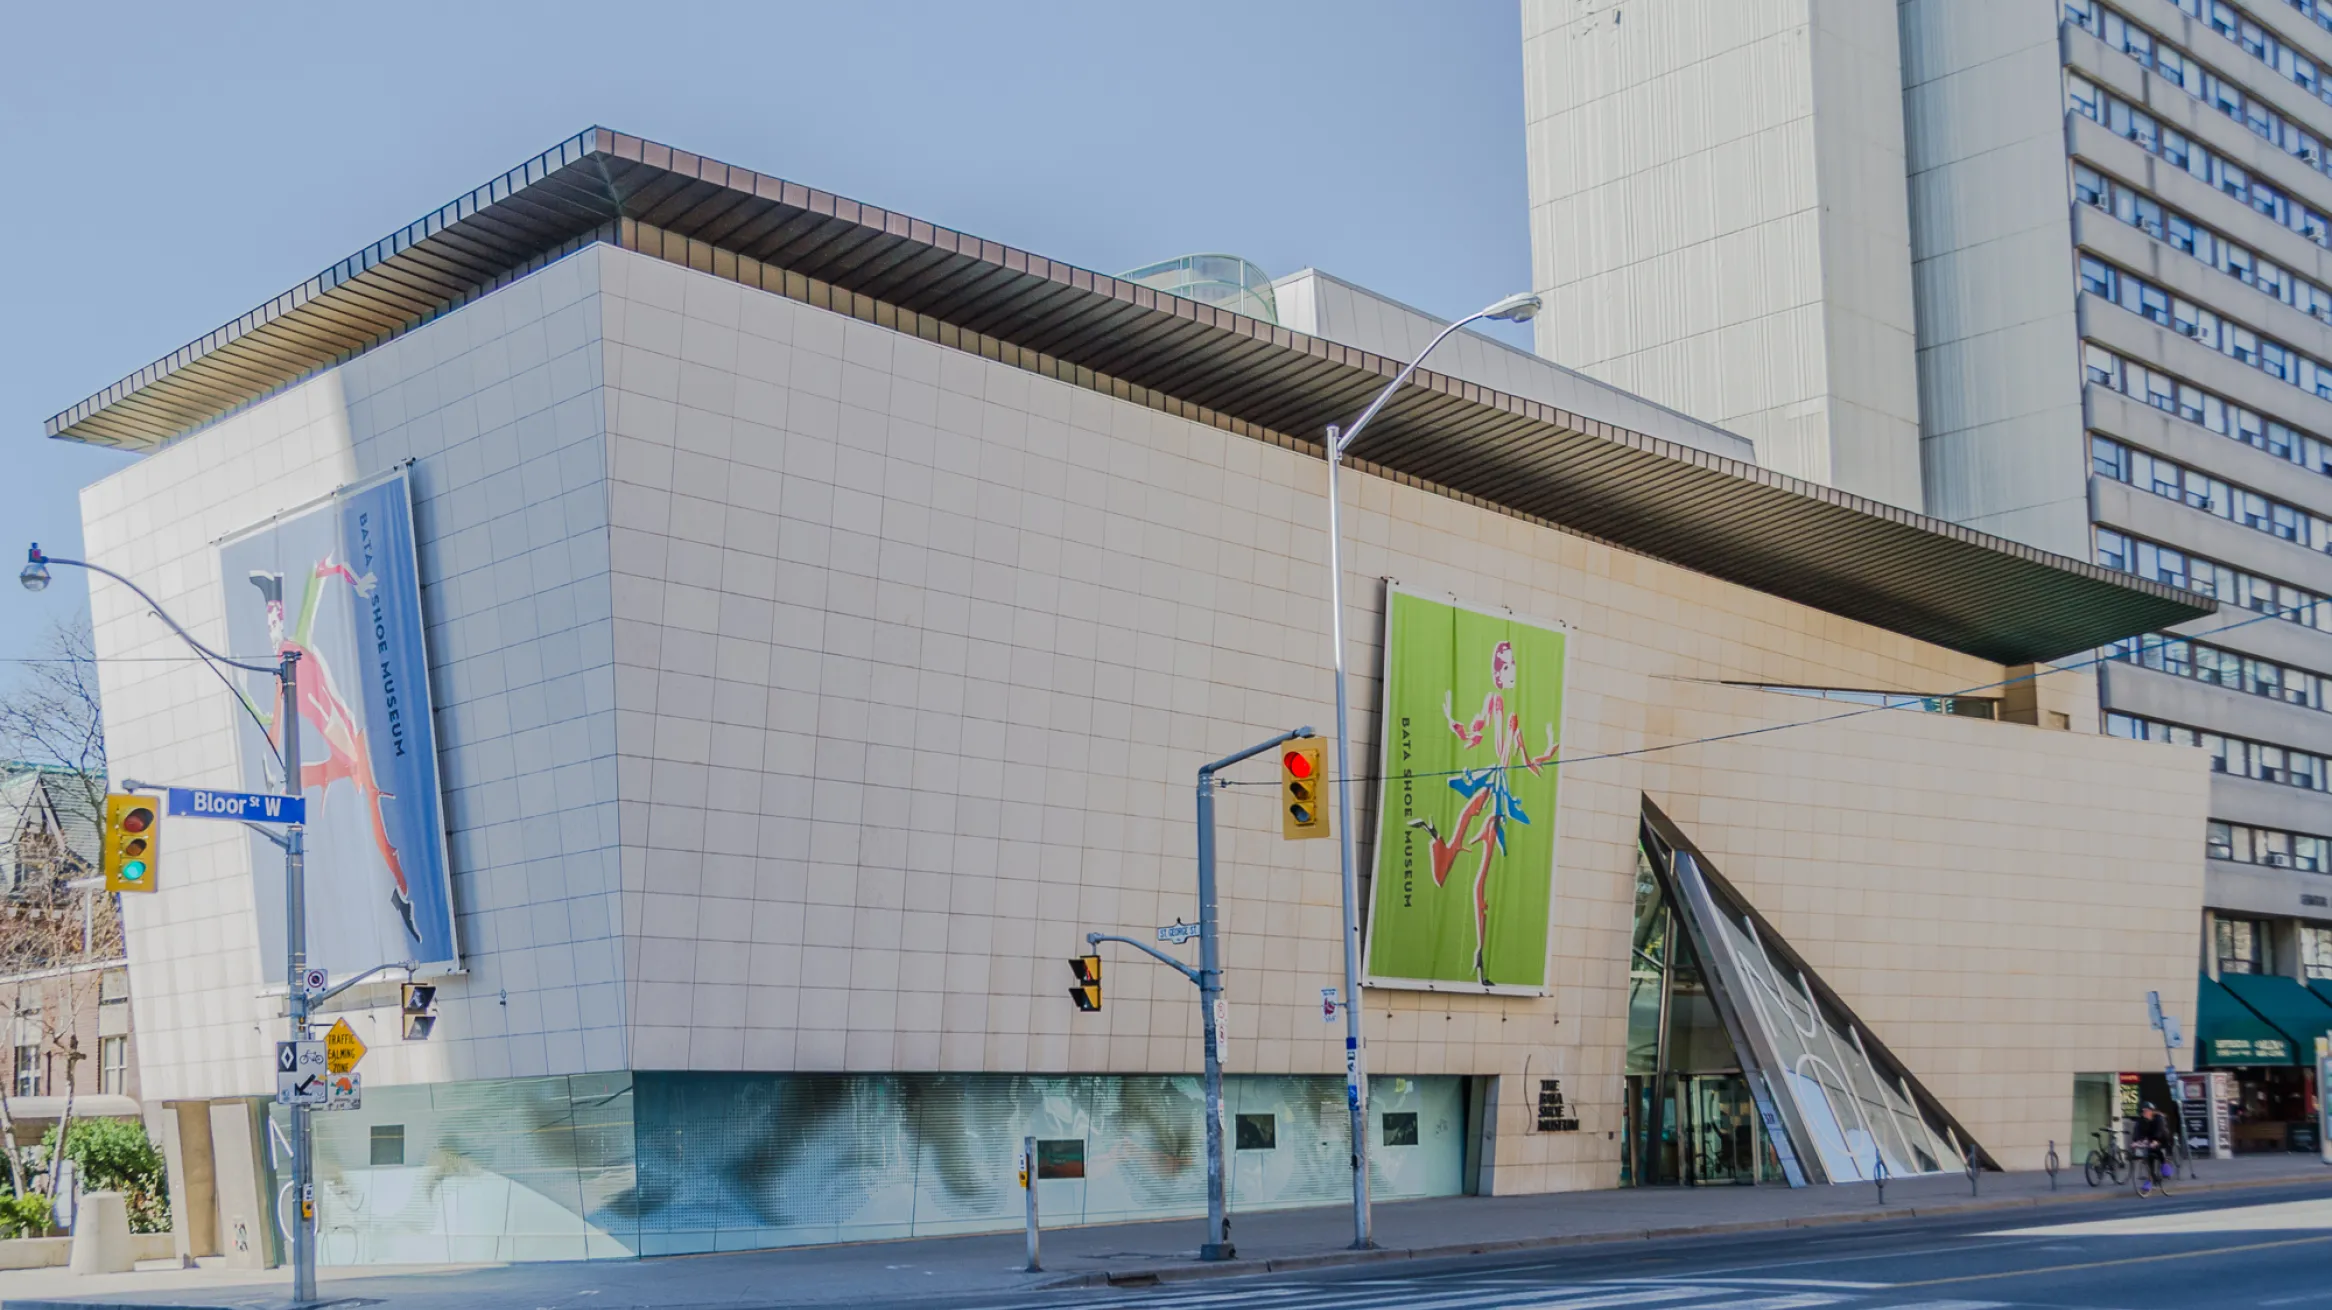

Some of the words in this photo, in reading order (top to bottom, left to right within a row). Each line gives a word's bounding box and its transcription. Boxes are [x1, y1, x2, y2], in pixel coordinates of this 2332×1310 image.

[359, 512, 373, 569] BATA
[371, 594, 388, 655] SHOE
[380, 661, 406, 757] MUSEUM
[1401, 717, 1411, 761] BATA
[1403, 768, 1413, 817] SHOE
[193, 791, 247, 815] Bloor
[249, 796, 260, 808] St
[264, 797, 281, 817] W
[1403, 830, 1413, 908] MUSEUM
[1168, 926, 1188, 937] GEORGE
[328, 1033, 355, 1045] TRAFFIC
[328, 1047, 356, 1060] CALMING
[332, 1062, 349, 1074] ZONE
[1540, 1079, 1560, 1091] THE
[1537, 1118, 1580, 1132] MUSEUM
